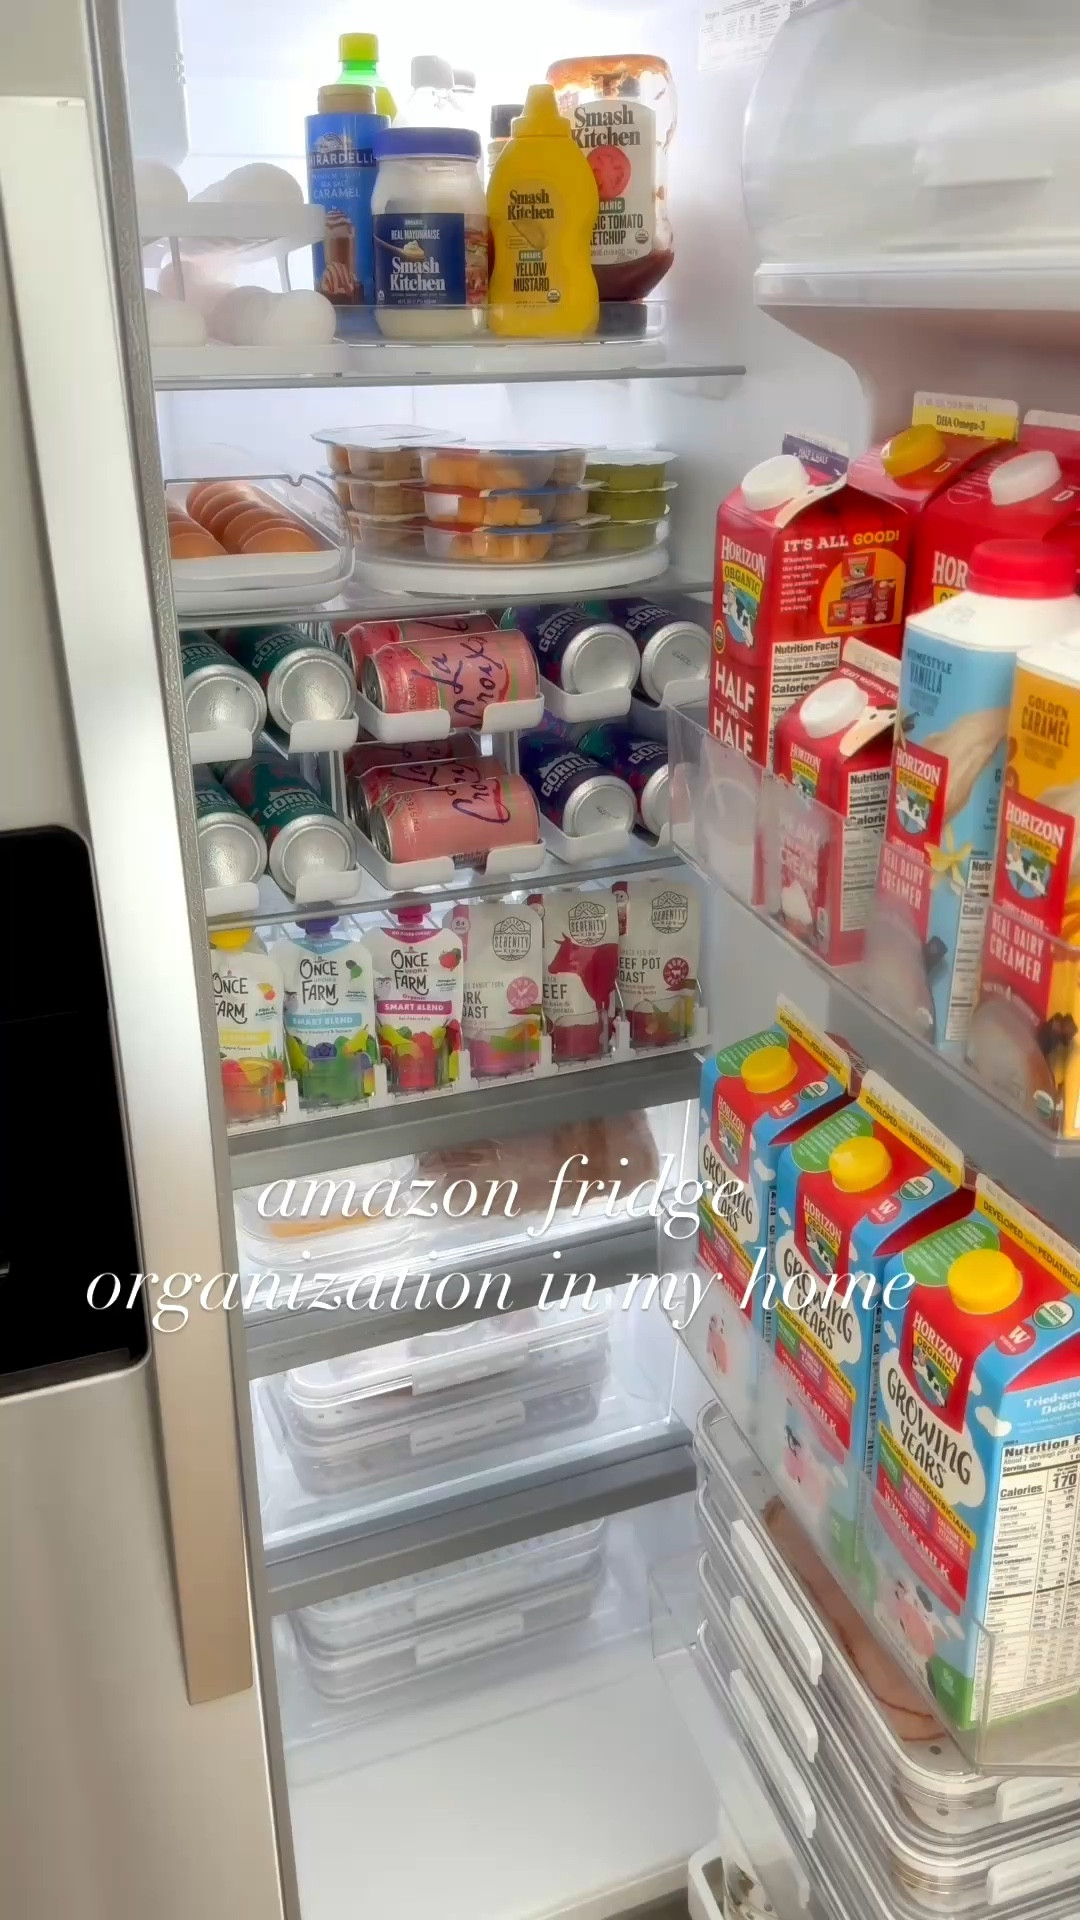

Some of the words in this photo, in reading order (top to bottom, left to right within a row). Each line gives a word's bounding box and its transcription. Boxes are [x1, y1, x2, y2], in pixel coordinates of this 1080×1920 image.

[574, 104, 635, 128] Smash
[571, 127, 640, 148] Kitchen
[308, 152, 373, 166] HIRARDELLI
[313, 188, 361, 199] CARAMEL
[509, 189, 549, 205] Smash
[507, 205, 554, 220] Kitchen
[607, 214, 643, 228] TOMATO
[391, 229, 404, 240] REAL
[404, 229, 441, 240] MAYONNAISE
[391, 256, 440, 274] Smash
[515, 262, 547, 276] YELLOW
[390, 273, 446, 291] Kitchen
[513, 277, 549, 292] MUSTARD
[936, 414, 952, 427] DHA
[952, 416, 985, 432] Omega-3
[783, 538, 813, 553] IT'S
[817, 535, 849, 550] ALL
[852, 530, 900, 546] GOOD!
[721, 535, 766, 581] HORIZON
[724, 566, 761, 595] ORGANIC
[774, 643, 814, 654] Nutrition
[815, 640, 839, 651] Facts
[715, 660, 755, 713] HALF
[910, 663, 943, 695] VANILLA
[726, 704, 740, 719] AND
[1028, 694, 1068, 720] GOLDEN
[713, 706, 754, 759] HALF
[1021, 706, 1071, 747] CARAMEL
[790, 742, 821, 774] HORIZON
[896, 748, 942, 786] HORIZON
[849, 772, 890, 785] Nutrition
[1005, 801, 1066, 847] HORIZON
[884, 847, 899, 870] REAL
[900, 860, 925, 887] DAIRY
[881, 867, 921, 910] CREAMER
[570, 919, 605, 932] SERENITY
[653, 909, 686, 922] SERENITY
[494, 936, 530, 948] SERENITY
[991, 911, 1011, 940] REAL
[1013, 924, 1044, 958] DAIRY
[299, 958, 339, 980] ONCE
[390, 949, 429, 970] ONCE
[642, 957, 661, 970] POT
[989, 933, 1042, 984] CREAMER
[211, 972, 248, 994] ONCE
[301, 979, 339, 1006] FARM
[394, 970, 430, 996] FARM
[384, 1003, 415, 1011] SMART
[325, 1016, 353, 1025] BLEND
[717, 1095, 746, 1134] HORIZON
[779, 1098, 794, 1111] W
[865, 1094, 898, 1128] DEVELOPED
[908, 1131, 952, 1176] PEDIATRICIANS
[703, 1144, 753, 1225] GROWING
[712, 1183, 739, 1233] YARS
[878, 1198, 897, 1216] W
[804, 1195, 842, 1243] HORIZON
[983, 1200, 1023, 1240] DEVELOPED
[807, 1219, 837, 1250] ORGANIC
[783, 1247, 853, 1343] GROWING
[797, 1294, 834, 1350] YEARS
[912, 1310, 963, 1370] HORIZON
[1009, 1325, 1031, 1344] W
[777, 1302, 805, 1336] DEVELOPED
[812, 1340, 853, 1394] PEDIATRICIANS
[916, 1336, 951, 1377] ORGANIC
[887, 1367, 973, 1485] GROWING
[900, 1419, 945, 1489] YEARS
[1004, 1439, 1069, 1457] Nutrition
[1004, 1457, 1022, 1465] About
[1030, 1451, 1056, 1461] servings
[1003, 1464, 1027, 1472] Serving
[880, 1424, 909, 1466] DEVELOPED
[918, 1475, 971, 1539] PEDIATRICIANS
[1000, 1484, 1043, 1498] Calories
[1052, 1473, 1077, 1489] 170
